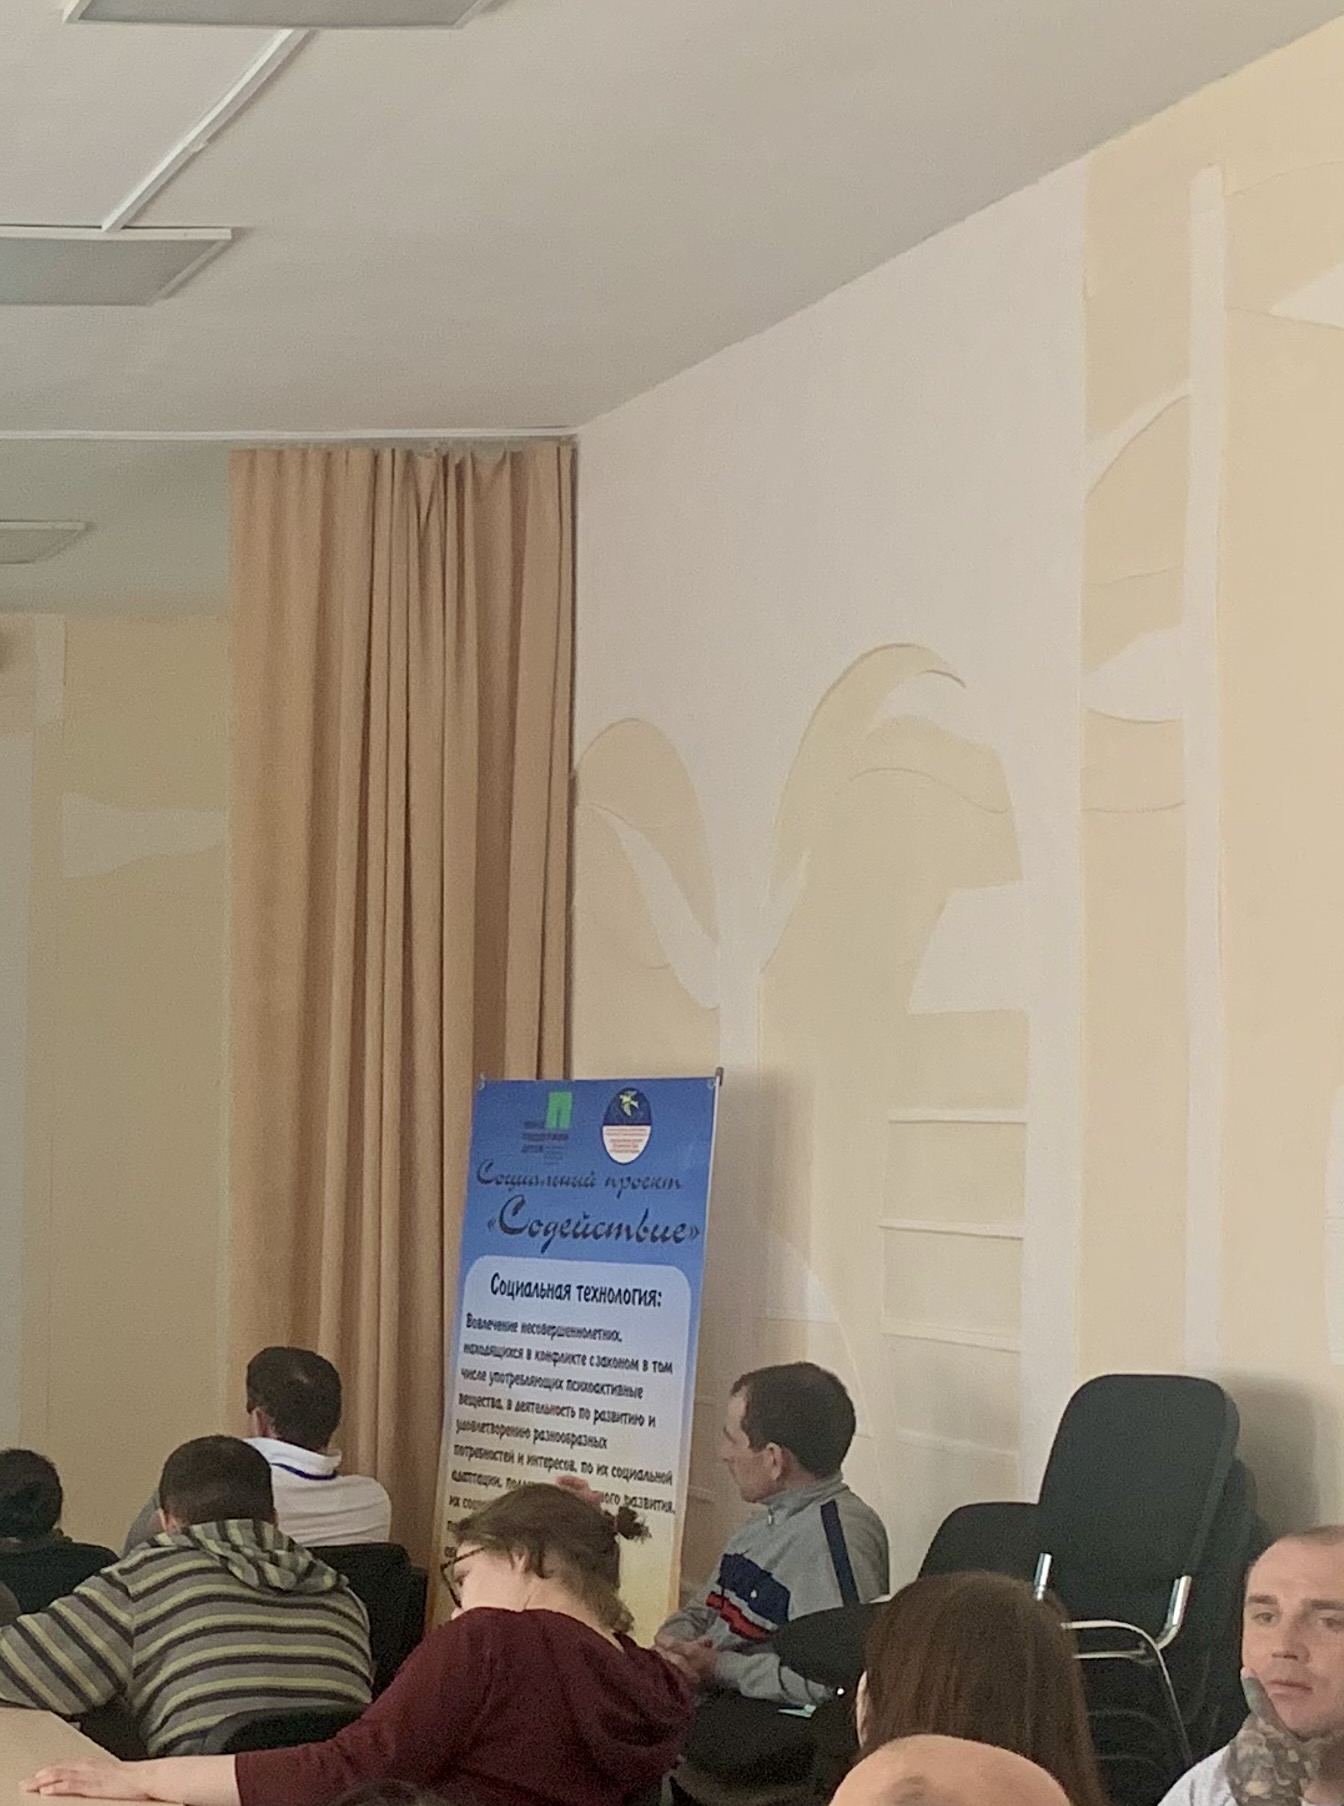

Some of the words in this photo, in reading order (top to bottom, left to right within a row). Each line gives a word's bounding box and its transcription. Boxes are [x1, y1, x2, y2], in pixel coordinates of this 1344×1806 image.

[476, 1158, 597, 1192] Социальный
[604, 1175, 681, 1199] проект
[487, 1194, 700, 1253] «Содействие»
[490, 1272, 571, 1301] Социальная
[576, 1284, 662, 1308] технология:
[466, 1312, 519, 1333] Вовлечение
[463, 1343, 524, 1361] находящихся
[526, 1348, 532, 1361] в
[535, 1350, 587, 1367] конфликте
[642, 1359, 649, 1372] в
[652, 1360, 673, 1375] том
[461, 1367, 487, 1381] числе
[488, 1370, 564, 1391] употребляющих
[566, 1379, 644, 1399] психоактивные
[506, 1398, 513, 1411] в
[515, 1400, 576, 1418] деятельность
[578, 1407, 591, 1420] по
[593, 1408, 645, 1427] развитию
[648, 1414, 656, 1428] и
[533, 1428, 608, 1449] разнообразных
[453, 1444, 515, 1464] потребностей
[517, 1452, 525, 1466] и
[581, 1461, 594, 1475] по
[596, 1464, 609, 1477] их
[611, 1466, 673, 1486] социальной
